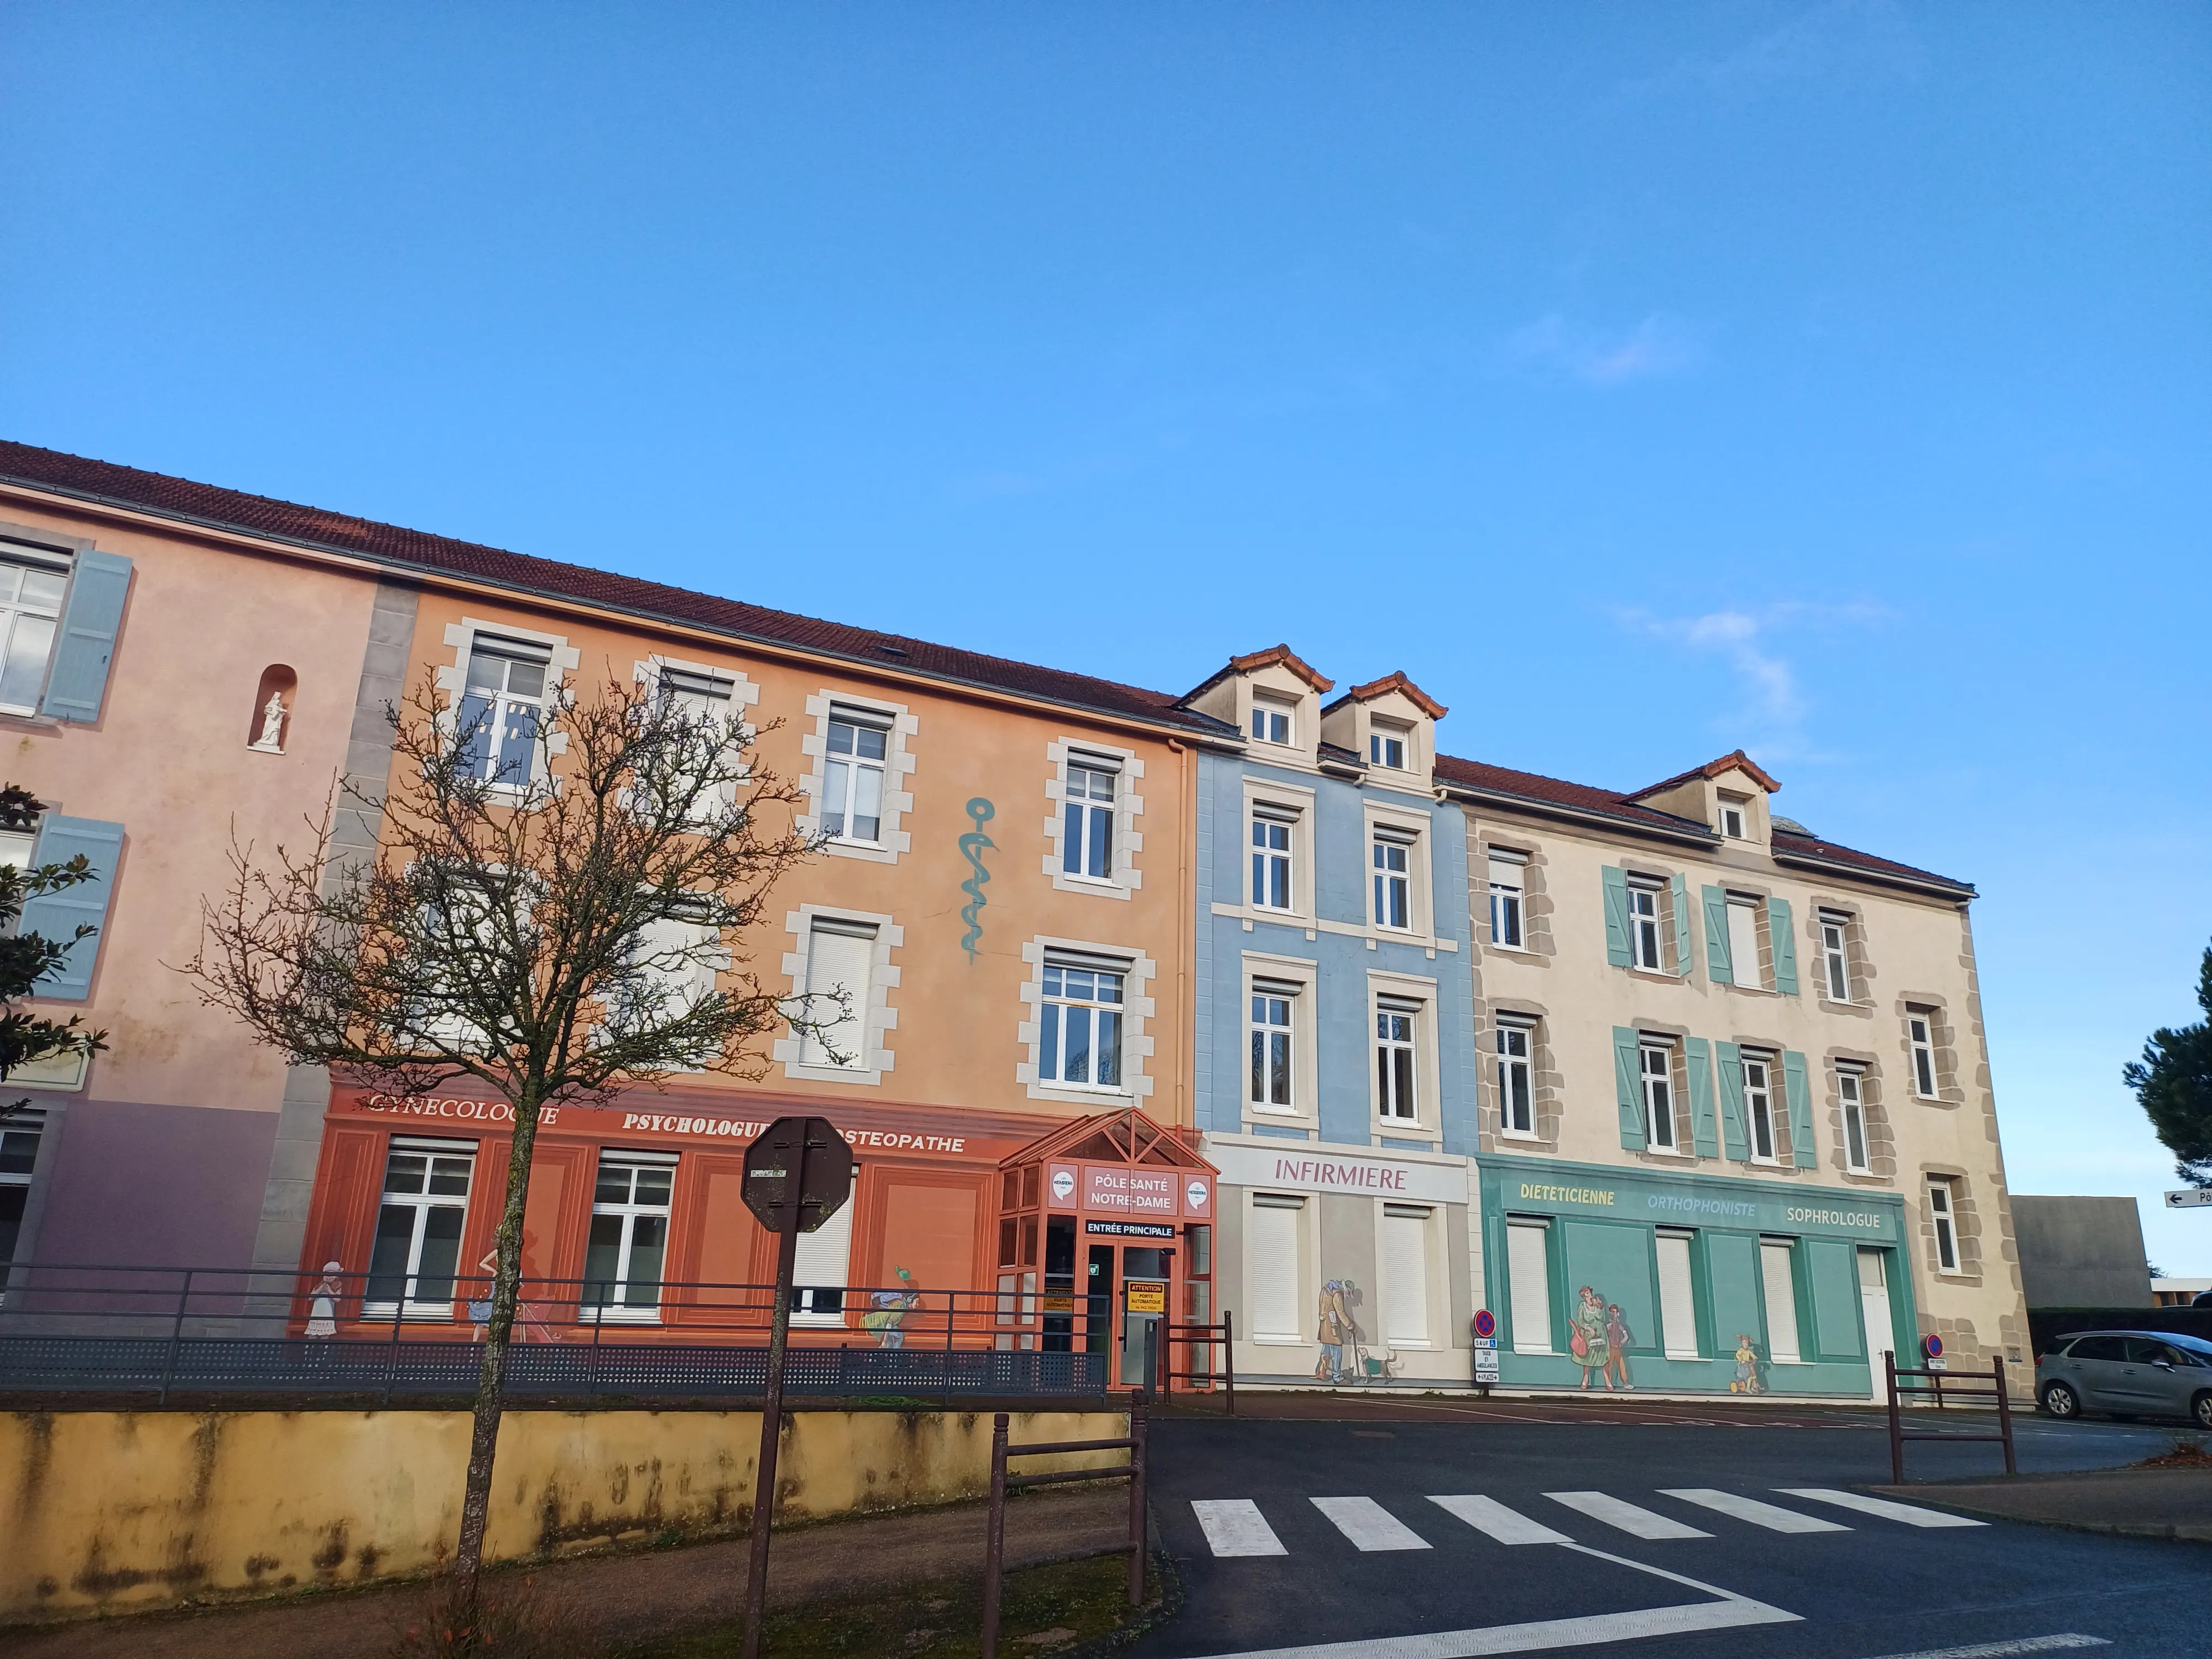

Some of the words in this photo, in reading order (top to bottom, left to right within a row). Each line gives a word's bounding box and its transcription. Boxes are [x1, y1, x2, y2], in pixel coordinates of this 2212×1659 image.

[1095, 1173, 1127, 1189] PÔLE
[1130, 1177, 1168, 1192] SANTÉ
[1274, 1159, 1408, 1190] INFIRMIERE
[1091, 1192, 1171, 1208] NOTRE-DAME
[1520, 1183, 1615, 1206] DIETETICIENNE
[2200, 1192, 2212, 1202] Pô
[1647, 1195, 1756, 1217] ORTHOPHONISTE
[1787, 1207, 1880, 1228] SOPHROLOGUE
[1087, 1222, 1122, 1233] ENTRÉE
[1123, 1225, 1172, 1237] PRINCIPALE
